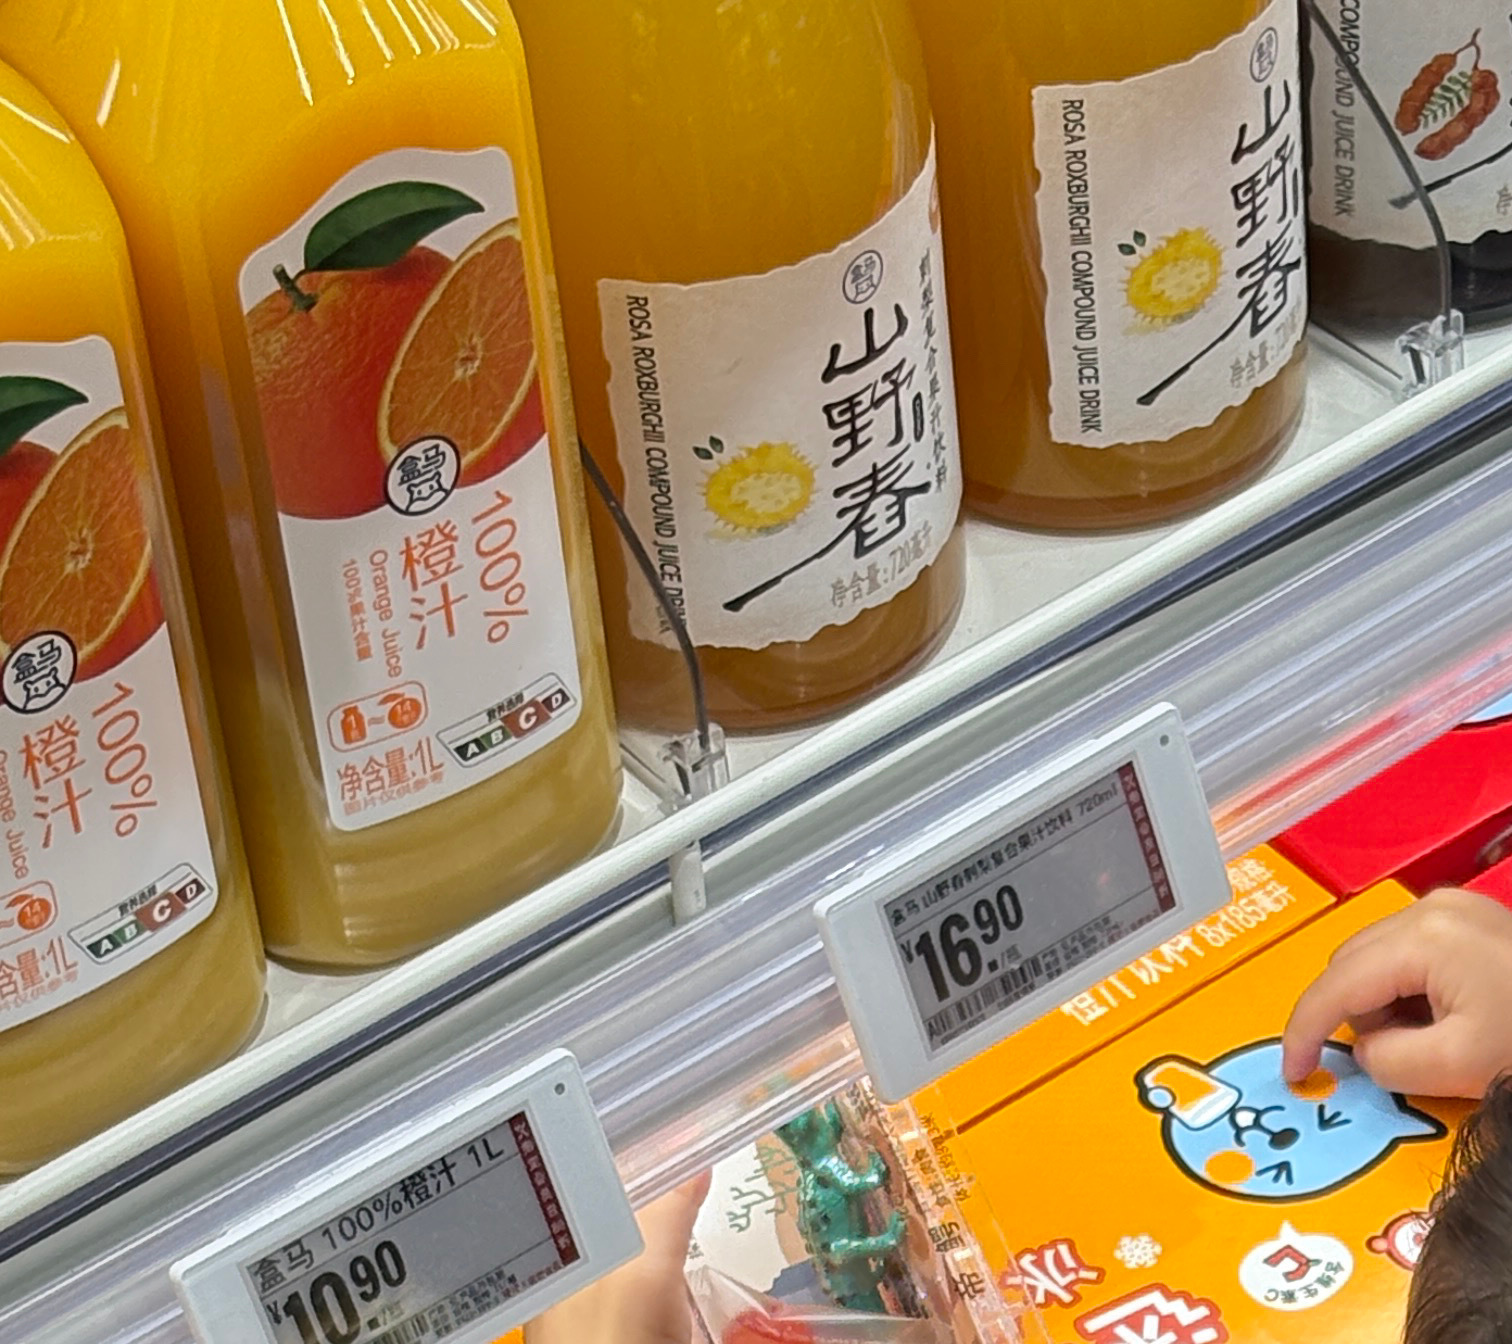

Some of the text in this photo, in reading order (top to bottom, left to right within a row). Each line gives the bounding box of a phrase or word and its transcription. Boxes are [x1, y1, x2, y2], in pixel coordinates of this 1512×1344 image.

[1333, 108, 1356, 161] JUICE
[1333, 164, 1356, 217] DRINK
[1063, 99, 1103, 433] ROSA ROXBURGHII COMPOUND JUICE DRINK
[626, 294, 651, 342] ROSA
[632, 346, 667, 444] ROXBURGHII
[396, 443, 447, 487] 盒马
[644, 446, 676, 540] COMPOUND
[400, 519, 468, 650] 橙汁
[472, 490, 529, 644] 100%
[652, 539, 682, 583] JUICE
[12, 638, 63, 684] 盒马
[369, 549, 403, 678] Orange Juice
[21, 714, 93, 849] 橙汁
[91, 681, 158, 838] 100%
[6, 828, 30, 879] Juice
[253, 1137, 505, 1292] 盒马 100%橙汁 1L
